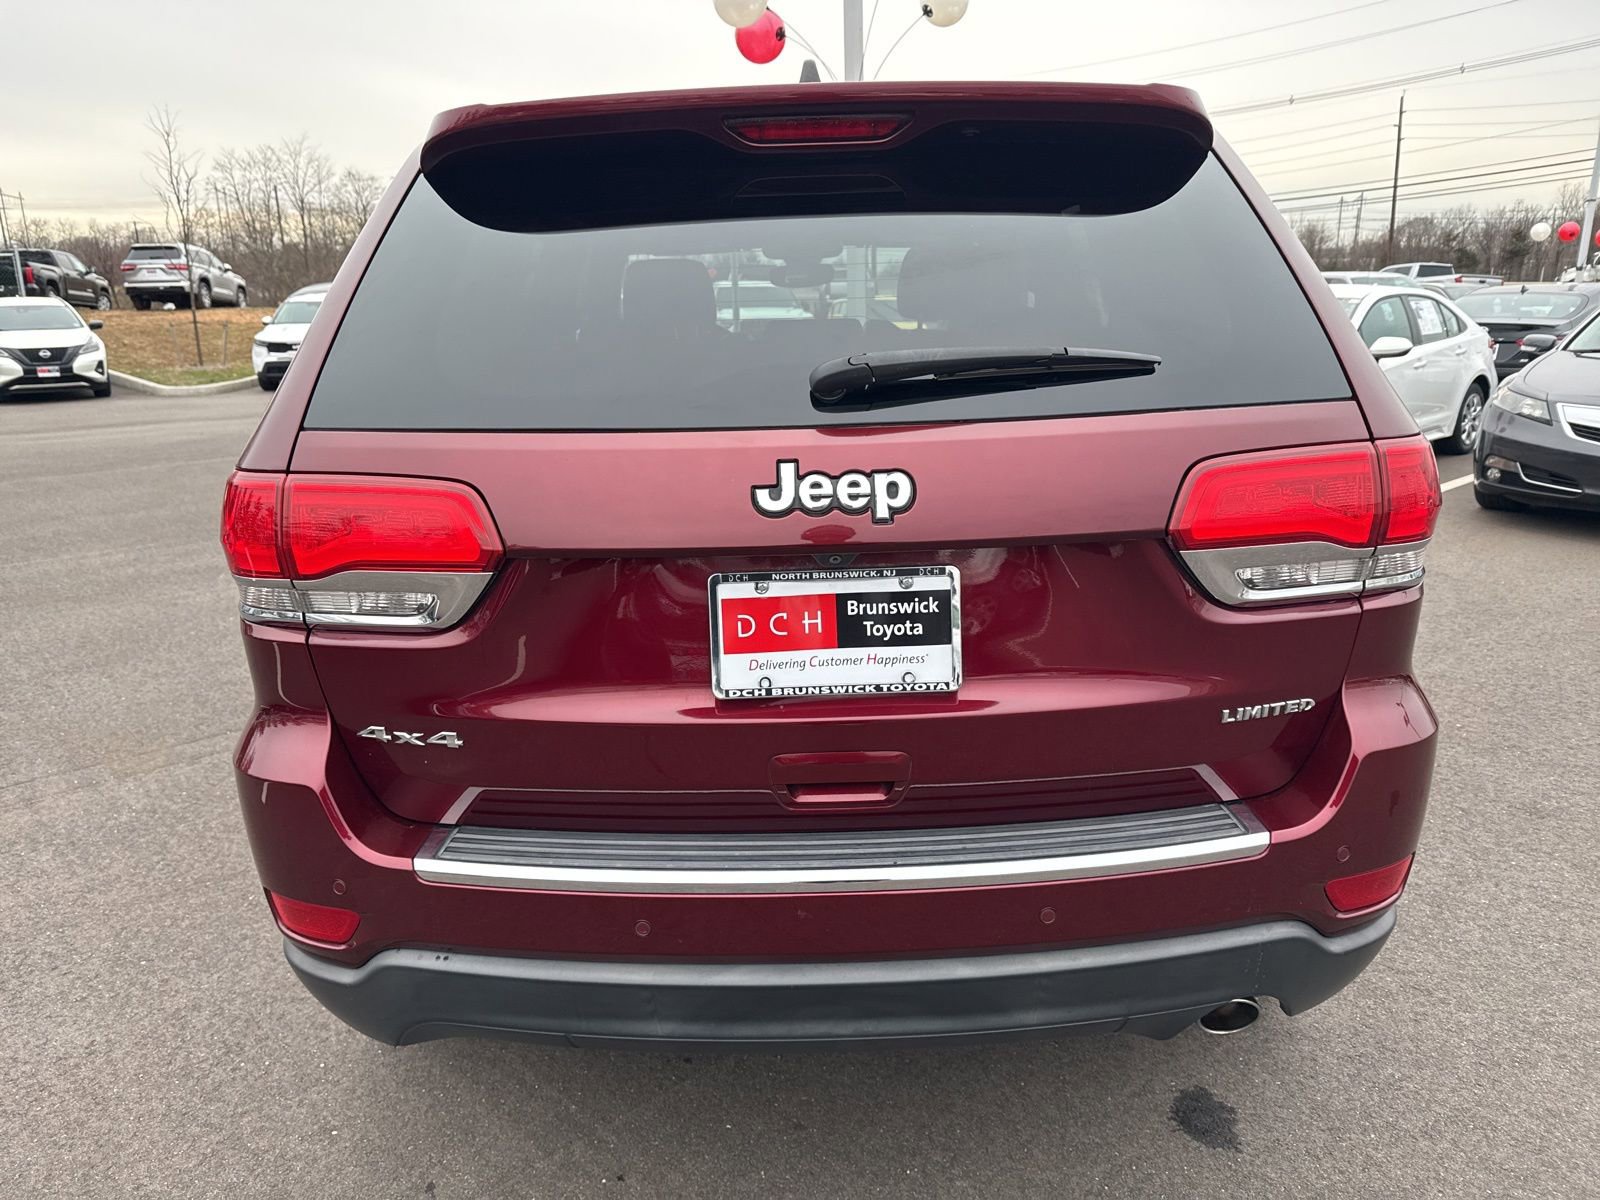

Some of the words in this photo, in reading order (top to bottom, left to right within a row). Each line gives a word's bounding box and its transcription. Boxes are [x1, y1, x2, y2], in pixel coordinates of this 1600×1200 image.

[752, 459, 917, 524] Jeep
[771, 572, 810, 581] NORTH
[883, 569, 896, 577] NJ
[847, 598, 940, 615] Brunswick
[863, 621, 923, 641] Toyota
[748, 658, 807, 672] Delivering
[809, 655, 864, 668] Customer
[866, 653, 926, 666] Happiness
[728, 689, 766, 698] DCH
[771, 685, 876, 696] BRUNSWICK
[879, 682, 950, 692] TOYOTA
[1221, 698, 1316, 723] LIMITED
[356, 725, 464, 749] 4x4
